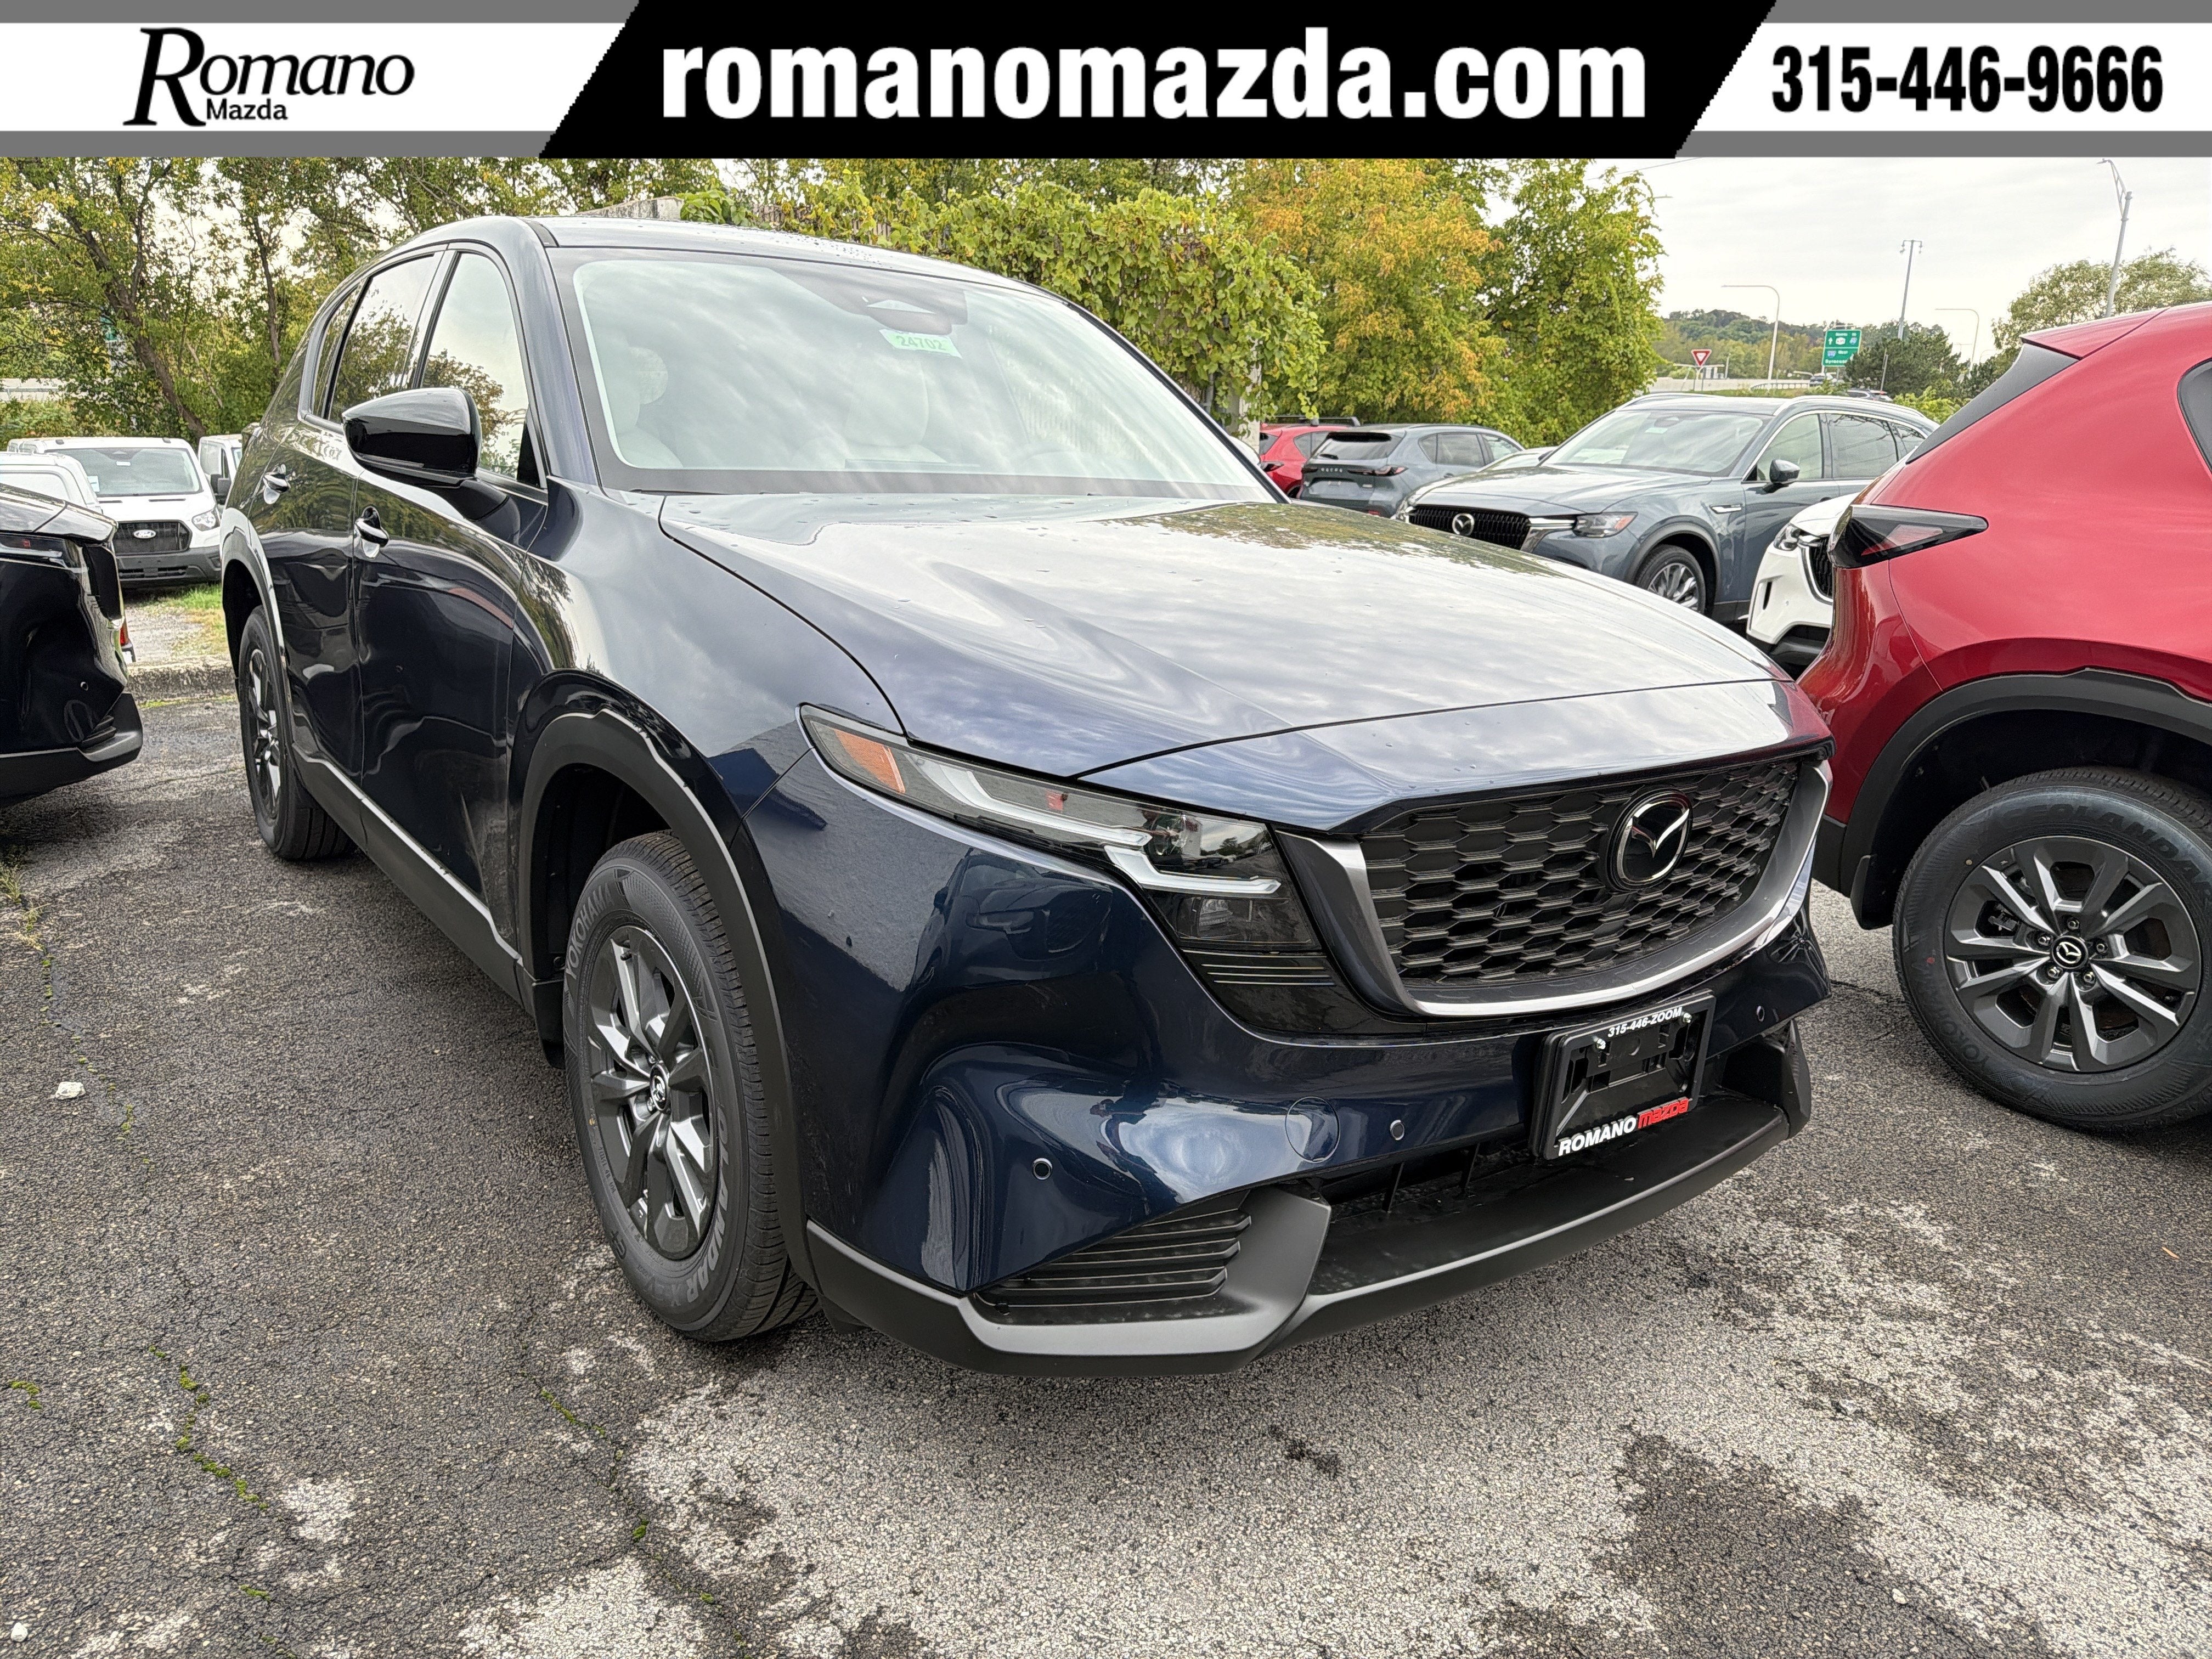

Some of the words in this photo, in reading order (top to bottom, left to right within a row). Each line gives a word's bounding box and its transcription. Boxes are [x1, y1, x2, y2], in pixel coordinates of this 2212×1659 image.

[896, 335, 947, 351] 24702
[566, 882, 615, 980] YOKOHAMA
[1607, 1006, 1683, 1037] 315-446-ZOOM
[1558, 1116, 1637, 1156] ROMANO
